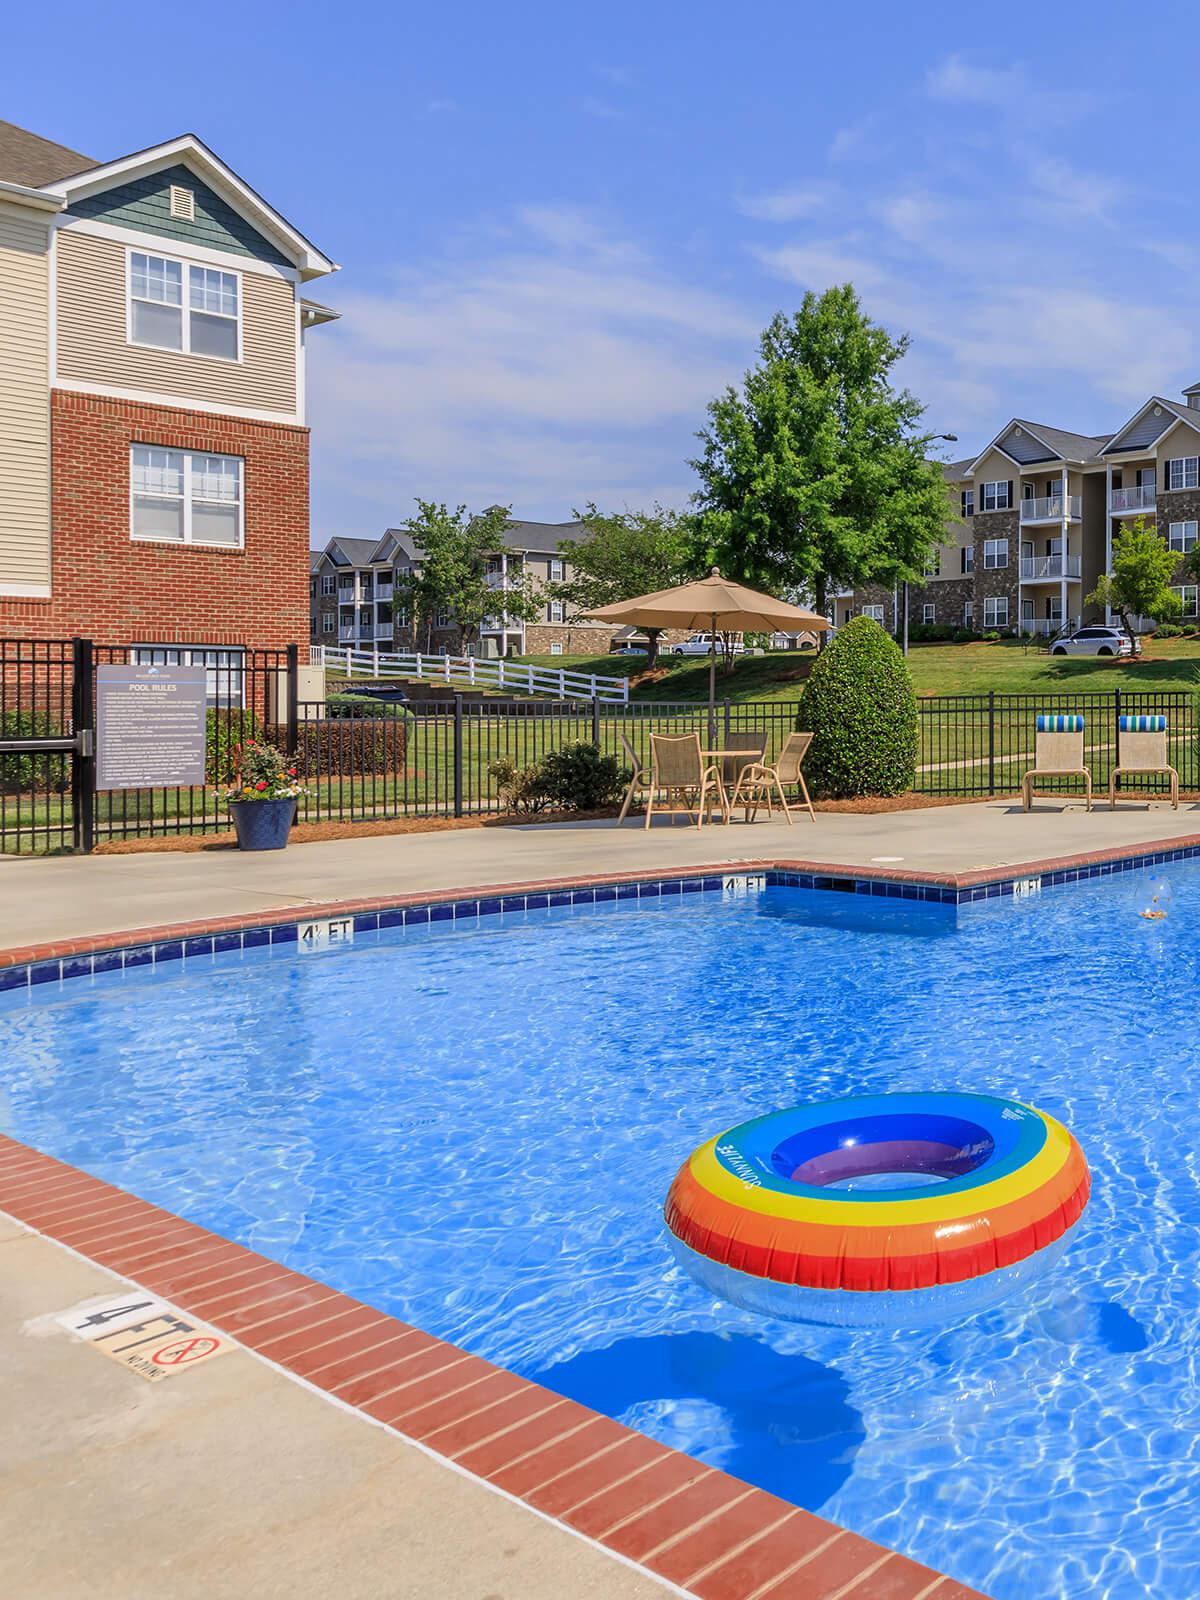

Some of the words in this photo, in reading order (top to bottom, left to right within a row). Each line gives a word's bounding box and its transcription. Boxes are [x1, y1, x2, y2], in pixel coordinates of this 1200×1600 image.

[152, 684, 176, 692] RULES
[328, 920, 350, 935] FT
[716, 1144, 763, 1190] SUNNYLIFE
[75, 1301, 155, 1329] 4
[94, 1314, 194, 1353] FT
